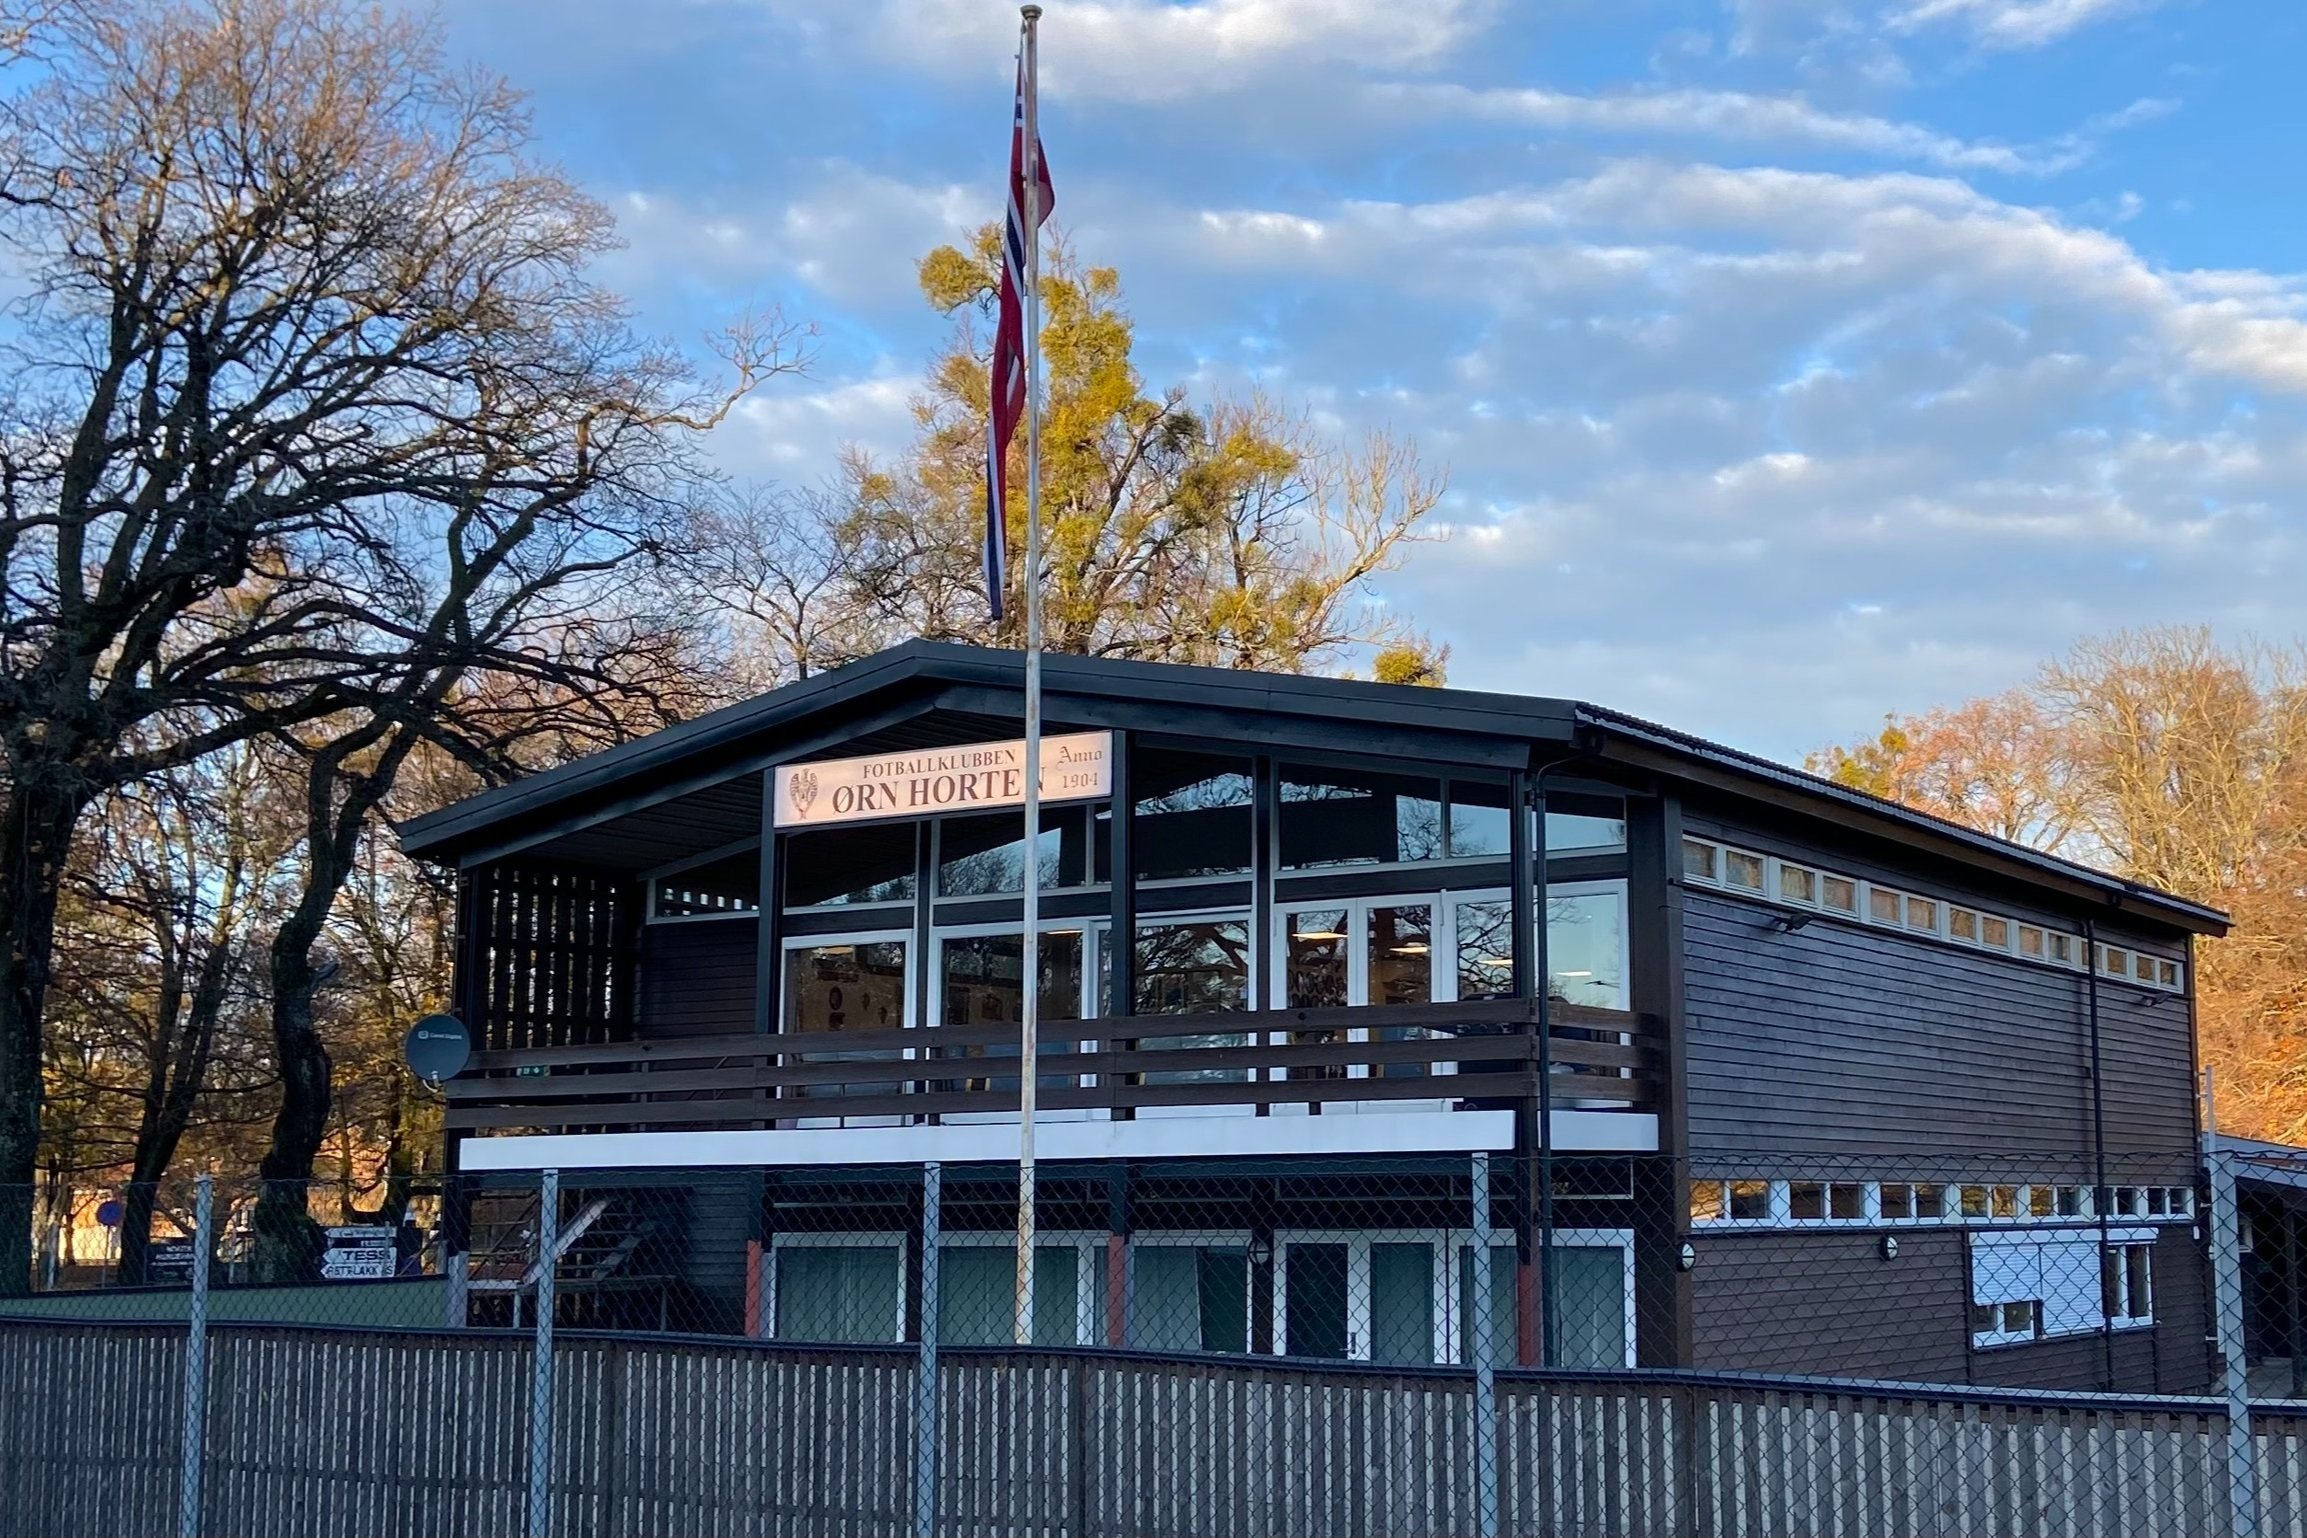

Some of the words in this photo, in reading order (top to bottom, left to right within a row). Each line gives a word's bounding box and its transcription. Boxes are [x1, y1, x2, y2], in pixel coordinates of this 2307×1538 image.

[863, 749, 1016, 778] FOTBALLKLUBBEN
[1056, 745, 1103, 771] Anno
[1063, 772, 1098, 789] 1904
[832, 780, 898, 815] ØRN
